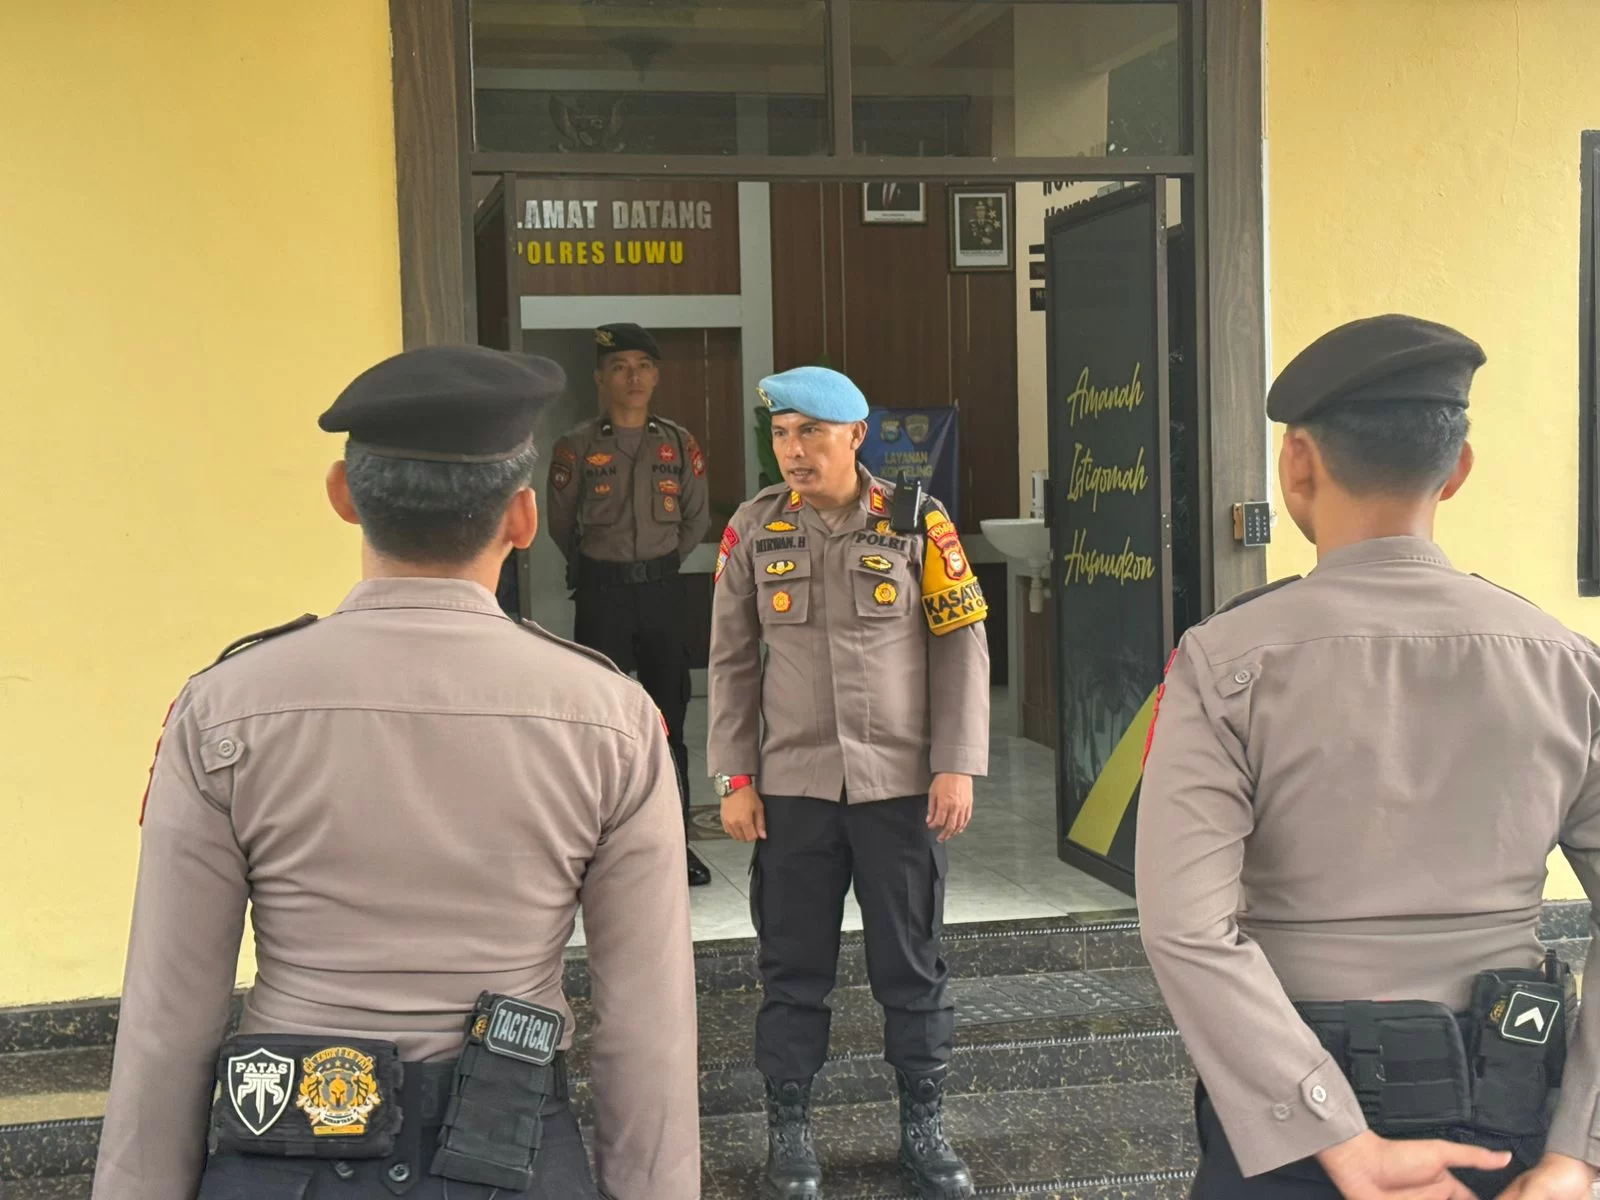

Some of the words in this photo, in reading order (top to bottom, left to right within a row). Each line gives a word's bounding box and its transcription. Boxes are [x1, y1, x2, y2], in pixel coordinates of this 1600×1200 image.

[517, 200, 598, 229] AMAT
[612, 200, 712, 229] DATANG
[615, 241, 684, 264] LUWU
[1067, 362, 1144, 426] Amanah
[1067, 442, 1148, 512] Istiqomah
[856, 532, 908, 550] POLRI
[493, 1009, 553, 1052] TACTICAL
[235, 1062, 288, 1075] PATAS
